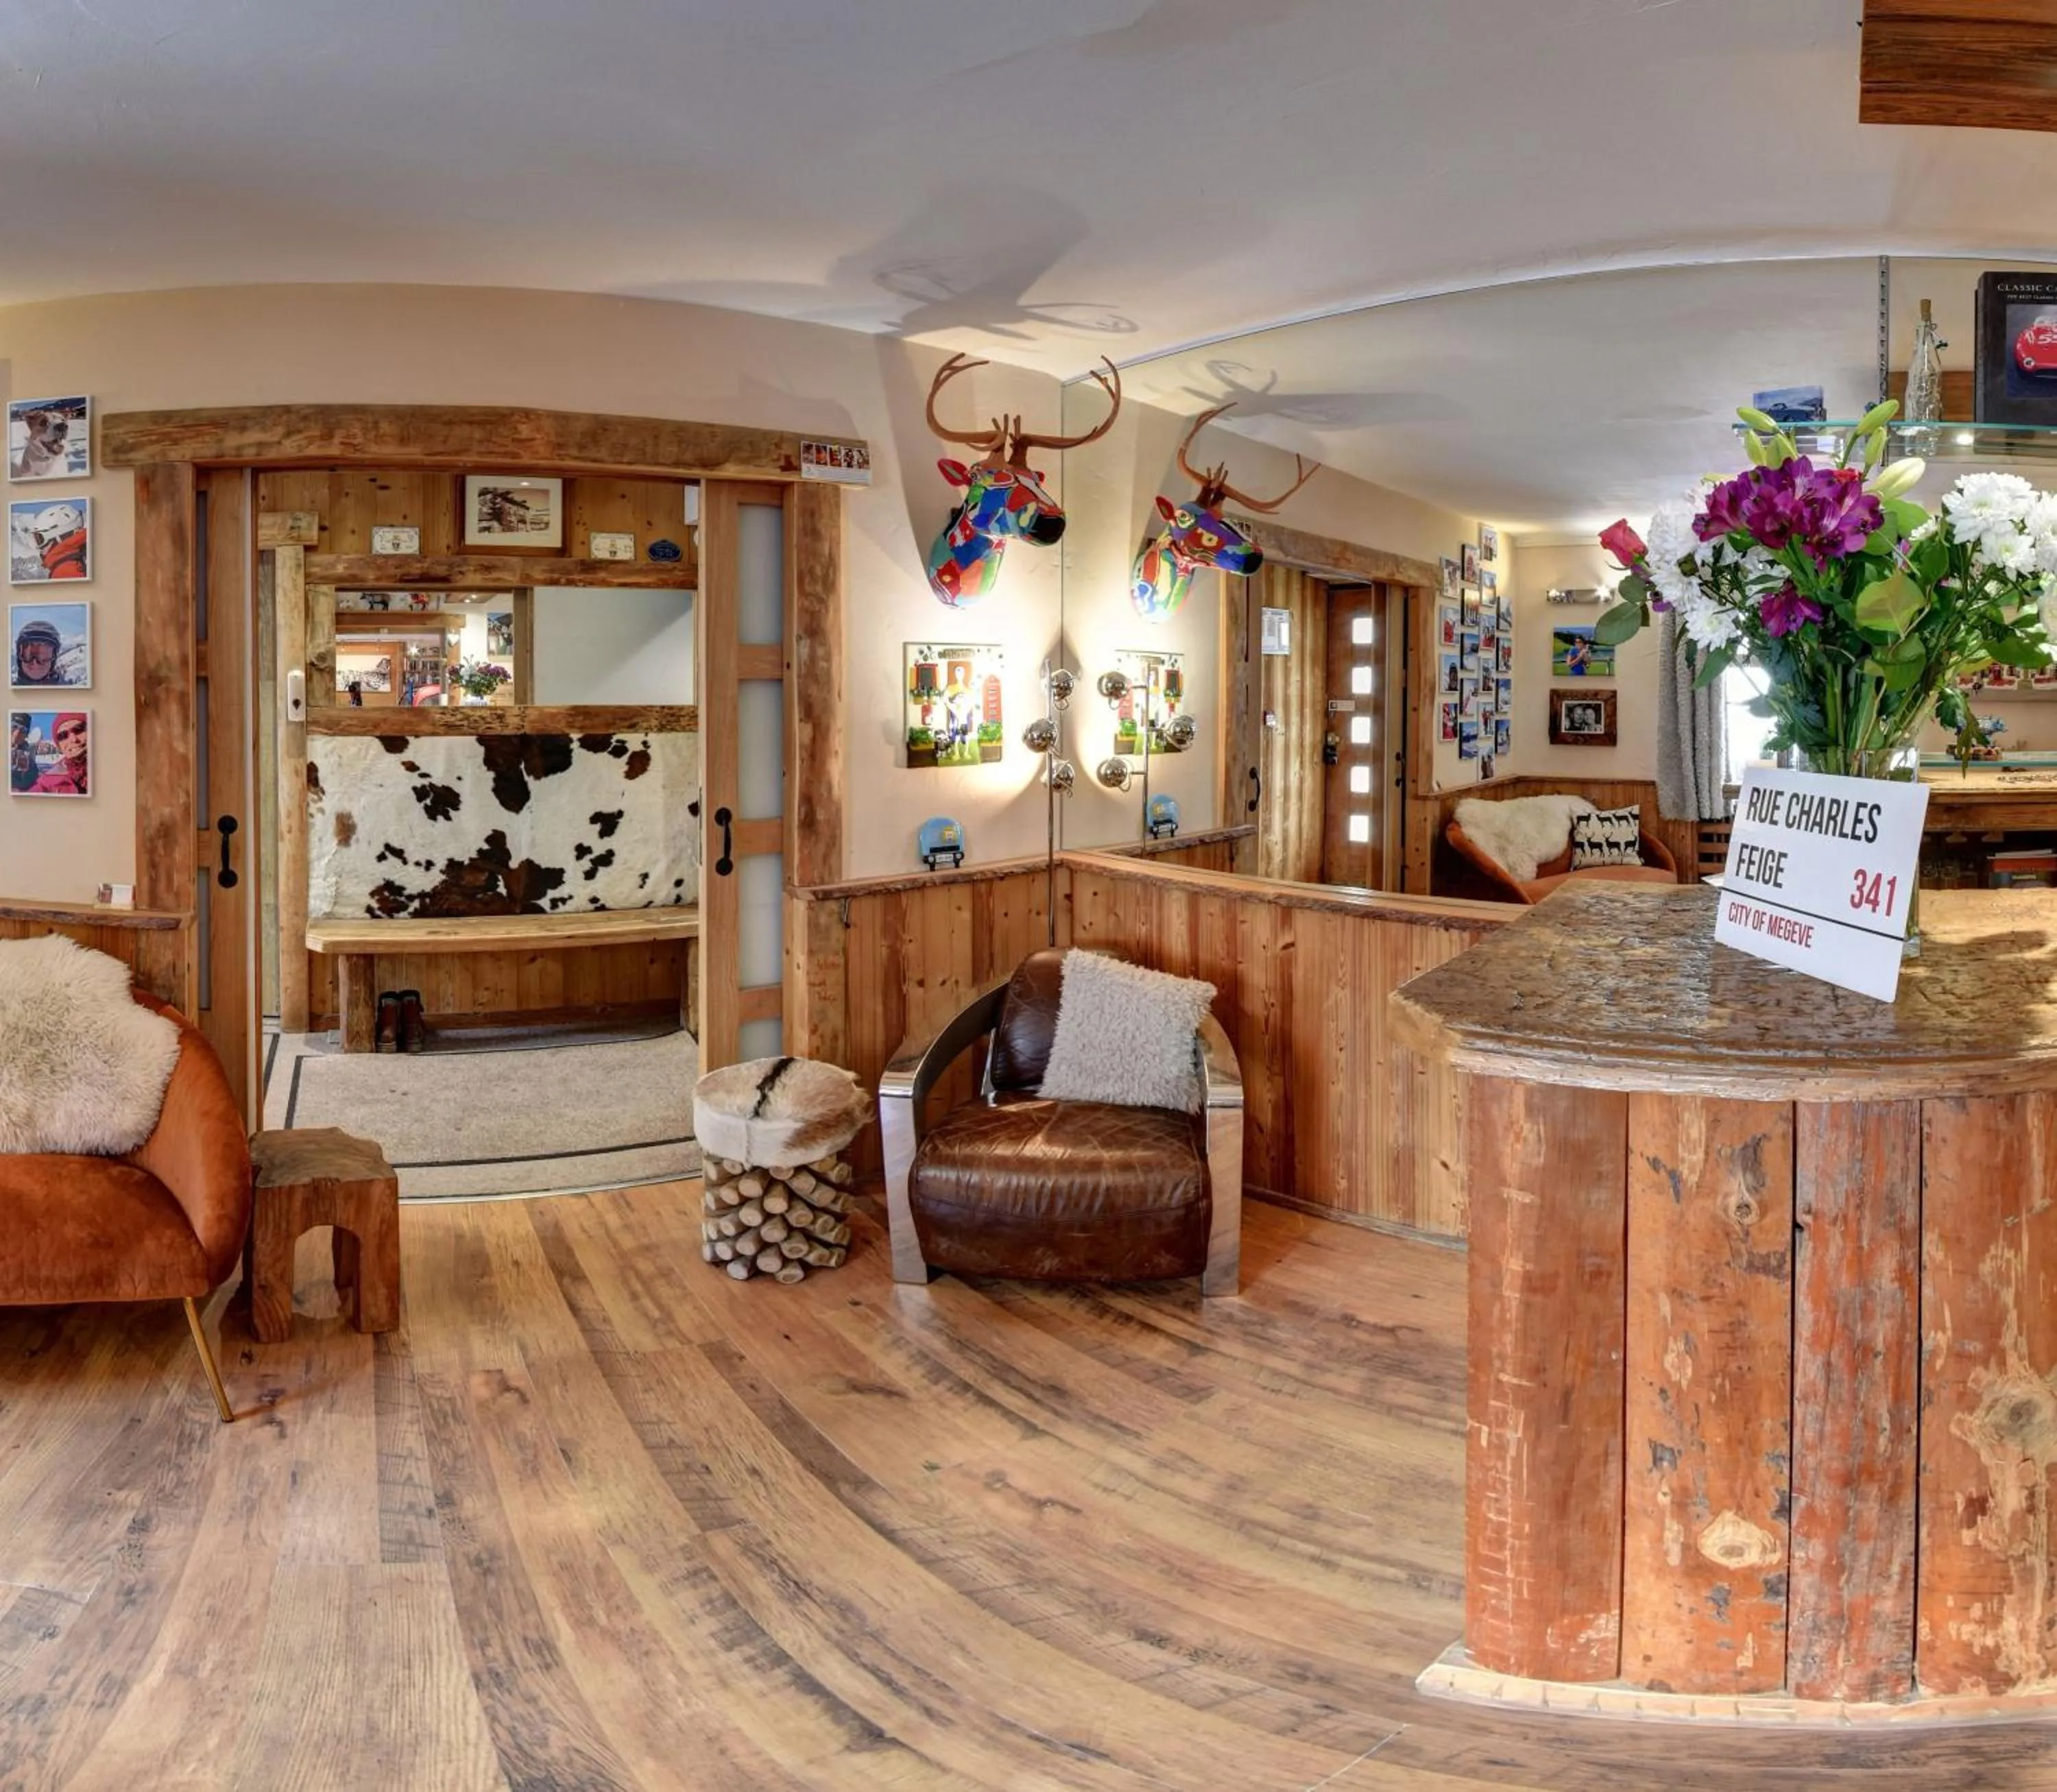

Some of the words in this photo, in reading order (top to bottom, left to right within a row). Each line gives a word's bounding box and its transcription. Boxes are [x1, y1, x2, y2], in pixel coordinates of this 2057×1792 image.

[1746, 786, 1785, 826] RUE
[1785, 792, 1881, 843] CHARLES
[1735, 843, 1788, 888] FEIGE
[1850, 868, 1897, 917] 341
[1728, 901, 1752, 925] CITY
[1752, 909, 1767, 932] OF
[1766, 914, 1814, 949] MEGEVE
